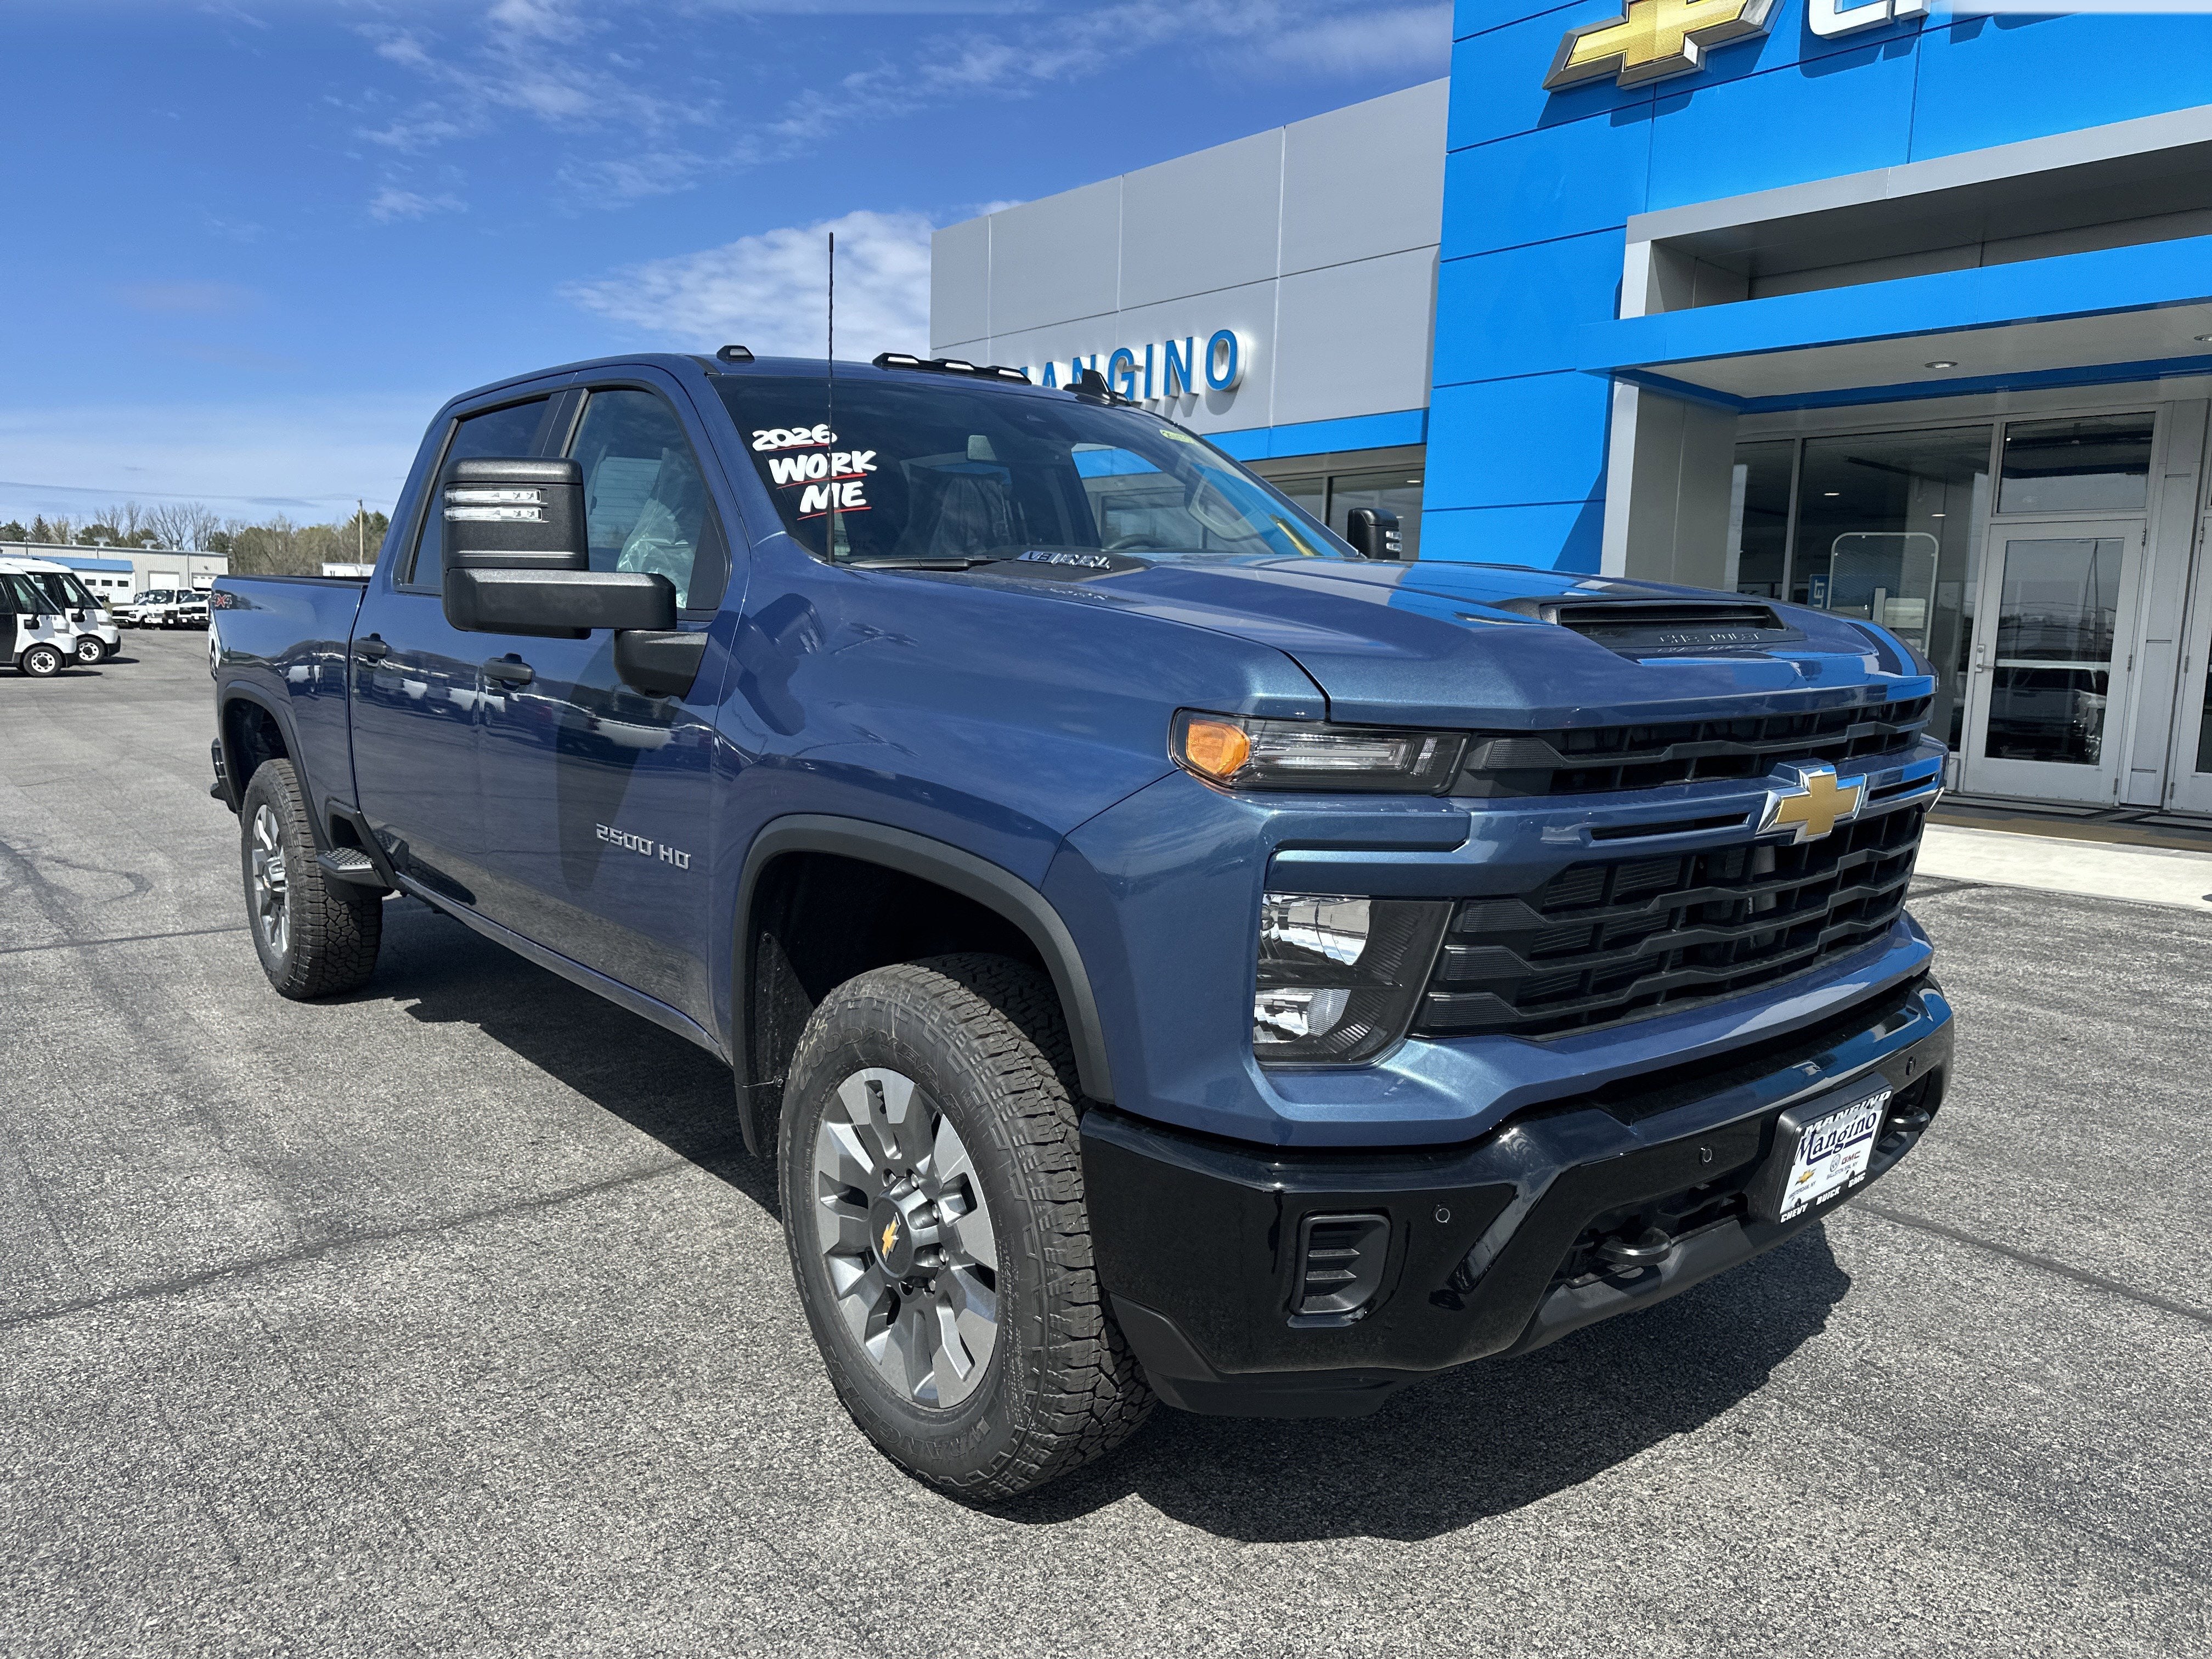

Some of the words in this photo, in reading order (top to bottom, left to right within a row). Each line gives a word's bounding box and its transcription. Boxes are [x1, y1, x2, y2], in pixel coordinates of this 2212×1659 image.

[1020, 329, 1242, 402] ANGINO
[752, 424, 837, 451] 2026
[769, 450, 877, 484] WORK
[799, 481, 866, 512] ME
[596, 823, 653, 856] 2500
[659, 844, 691, 870] HD
[1803, 1091, 1892, 1137] MANGINO
[1800, 1113, 1876, 1165] Mangino
[1841, 1150, 1861, 1165] GMC
[1780, 1203, 1808, 1223] CHEVY
[1816, 1186, 1841, 1205] BUICK
[1848, 1172, 1866, 1188] GMC
[824, 1345, 991, 1460] WRANGLER
